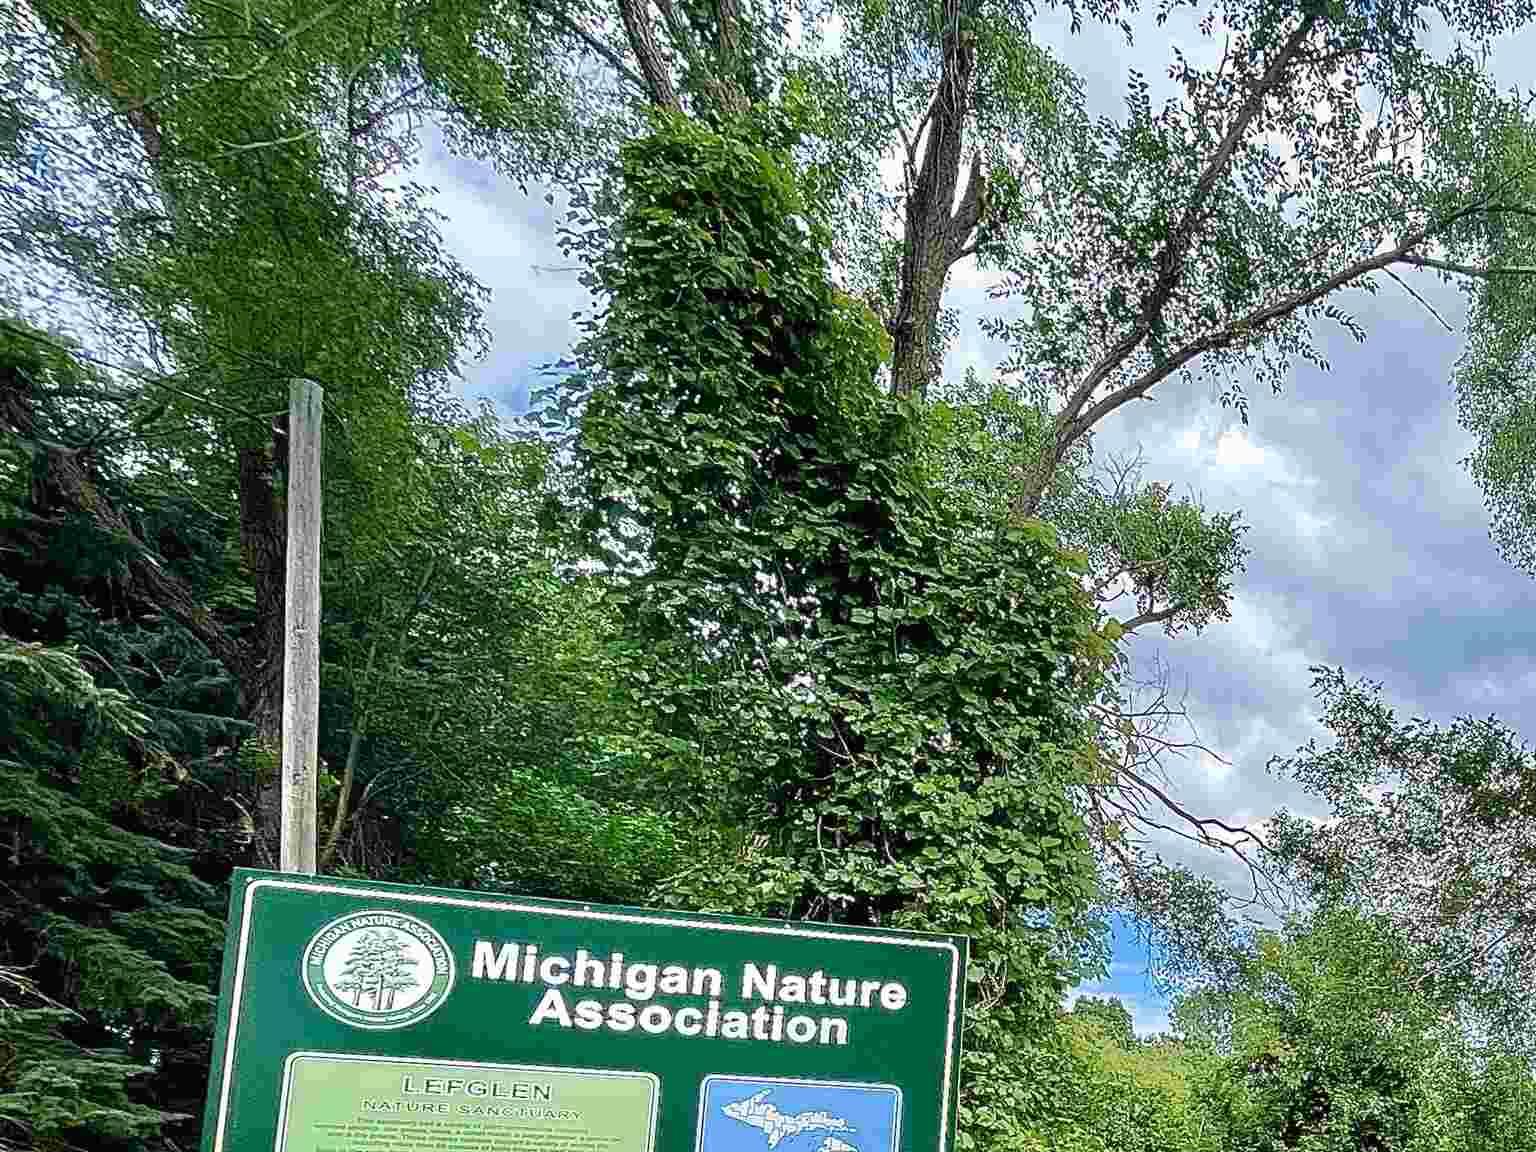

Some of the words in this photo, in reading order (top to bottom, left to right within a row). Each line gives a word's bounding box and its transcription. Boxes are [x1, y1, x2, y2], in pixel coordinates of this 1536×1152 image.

[350, 915, 400, 928] NATURE
[471, 940, 721, 1000] Michigan
[741, 961, 908, 1010] Nature
[528, 987, 850, 1046] Association
[402, 1076, 553, 1101] LEFGLEN
[362, 1099, 450, 1115] NATURE
[459, 1103, 585, 1120] SANCTUARY
